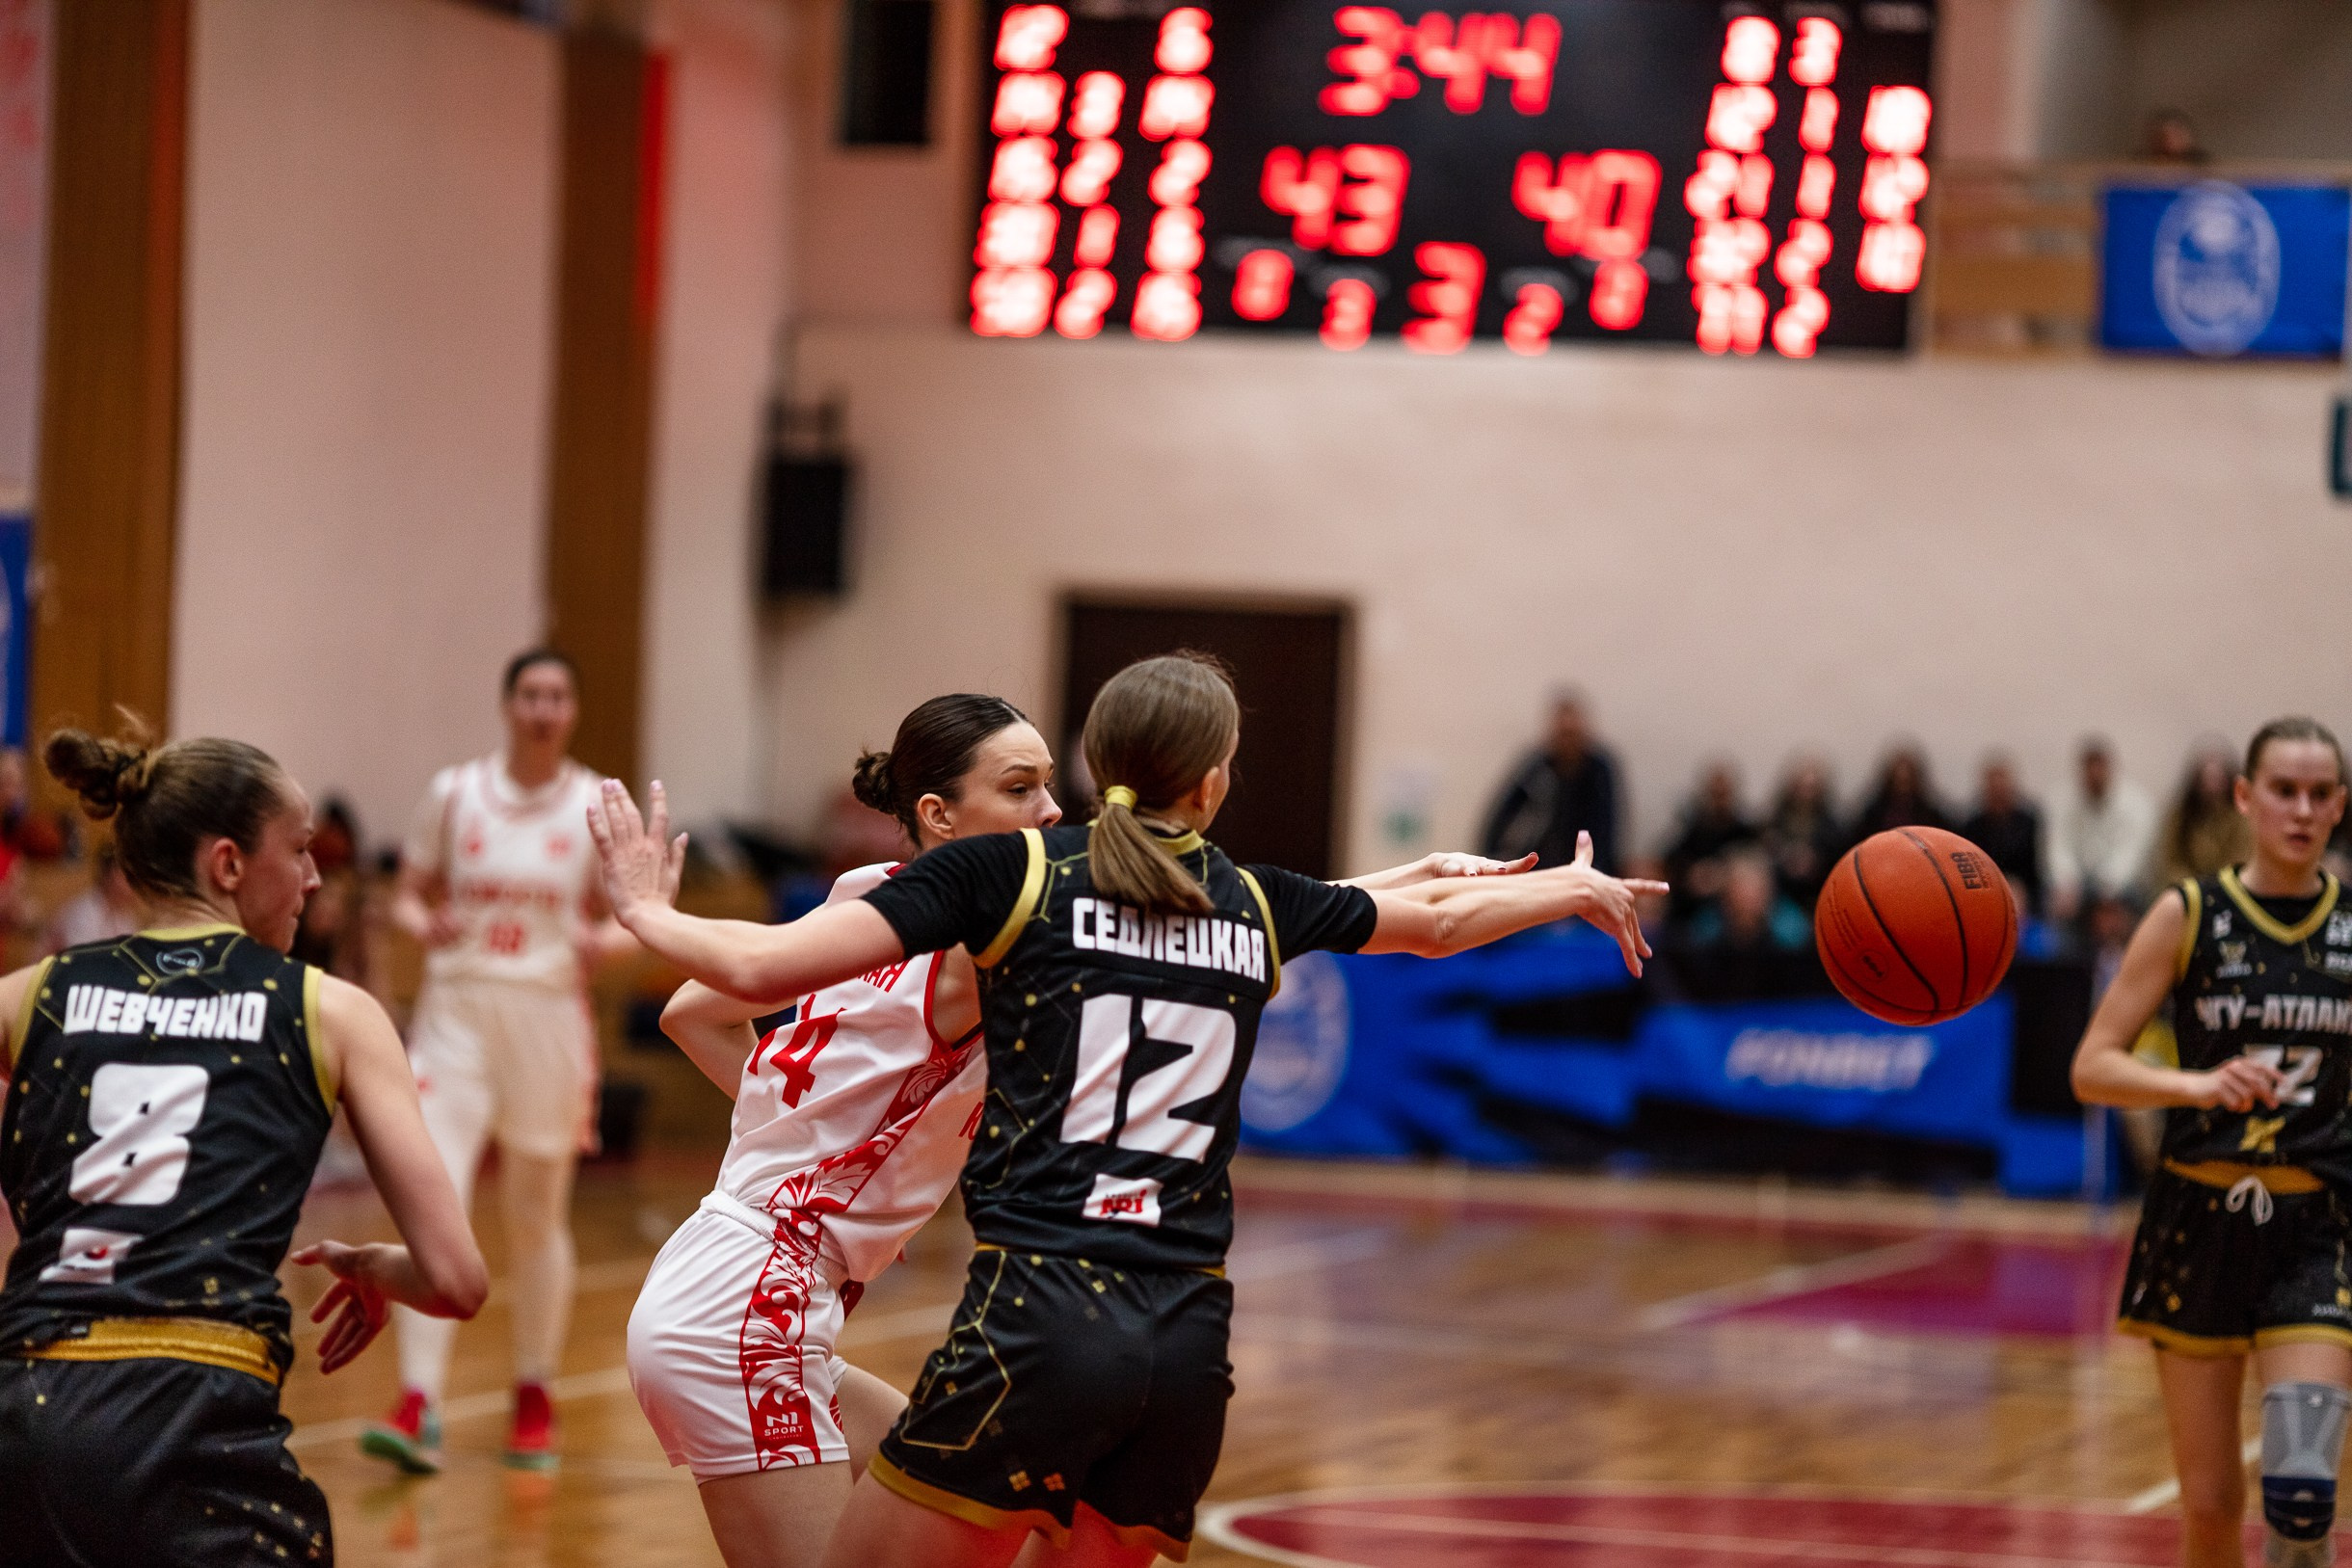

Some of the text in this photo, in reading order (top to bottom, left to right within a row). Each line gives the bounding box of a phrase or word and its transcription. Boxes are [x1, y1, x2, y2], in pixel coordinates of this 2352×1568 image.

[1318, 5, 1564, 116] 3:44
[1260, 144, 1410, 256] 43
[1510, 148, 1663, 260] 40
[1400, 240, 1487, 355] 3
[1950, 852, 1982, 889] FIBA
[1073, 897, 1266, 983] СЕДЛЕЦКАЯ
[63, 984, 268, 1043] ШЕВЧЕНКО
[68, 1062, 210, 1206] 8
[1060, 993, 1237, 1164] 12
[764, 1425, 804, 1437] SPORT
